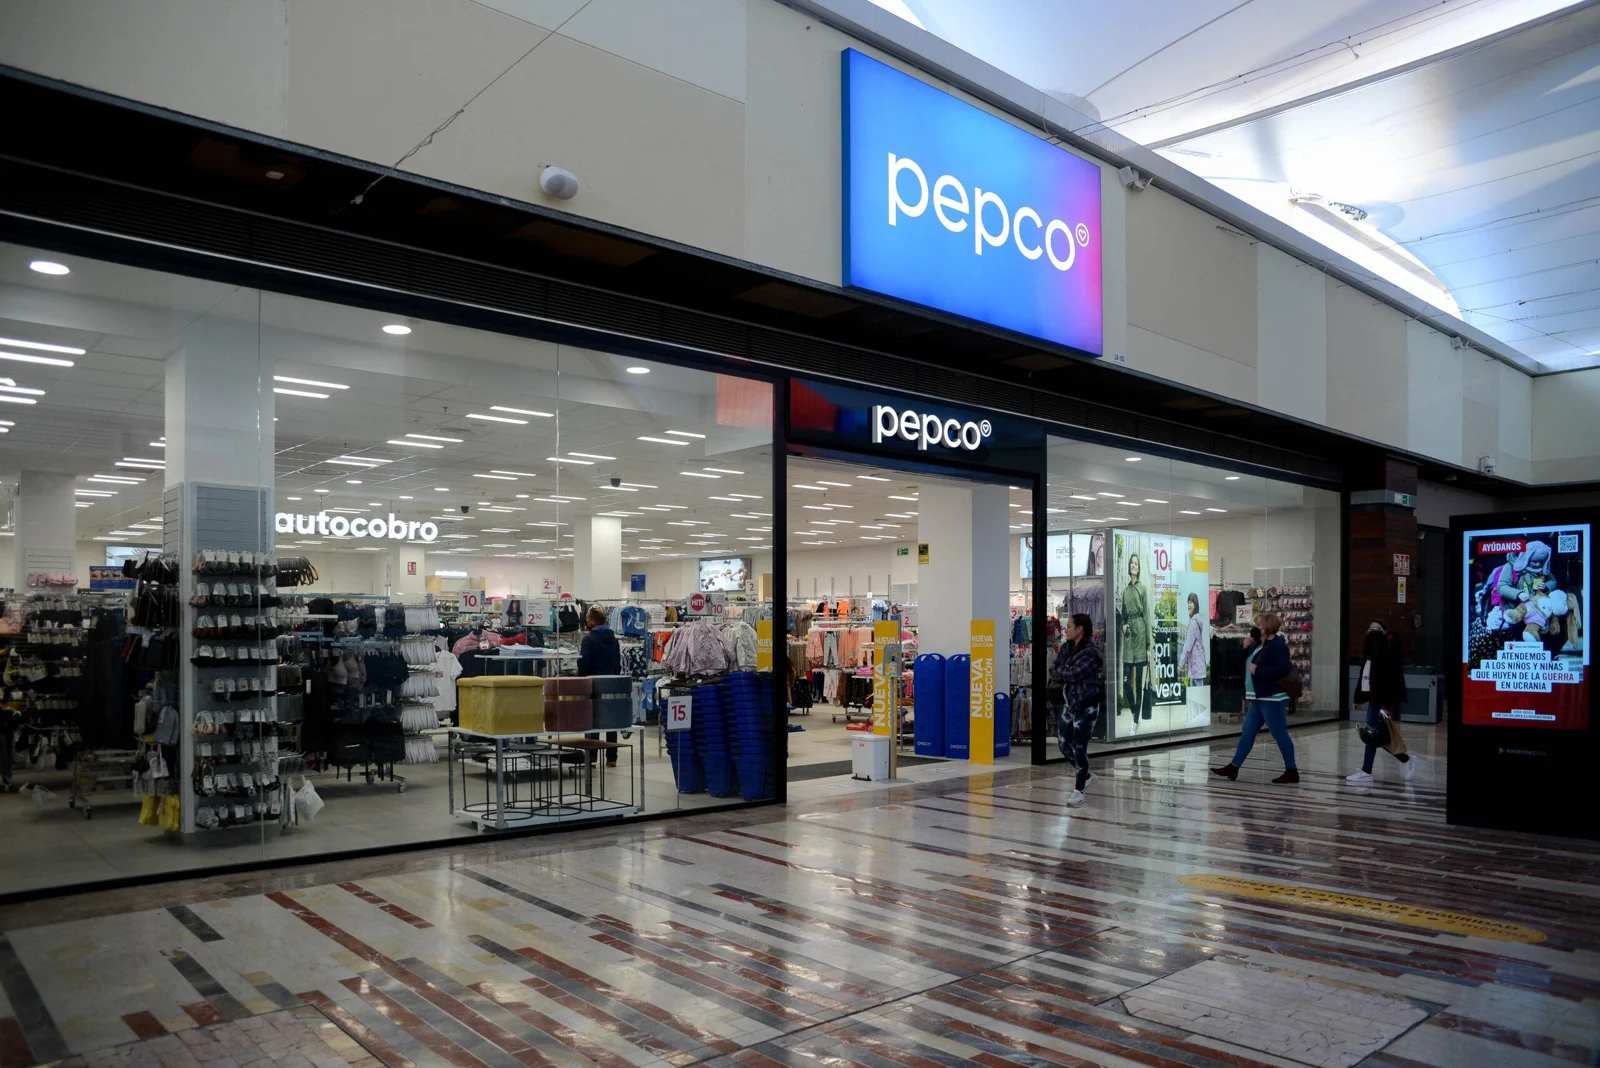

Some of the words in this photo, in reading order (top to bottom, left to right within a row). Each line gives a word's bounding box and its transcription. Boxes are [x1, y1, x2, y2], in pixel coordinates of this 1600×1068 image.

[888, 152, 1076, 271] pepco
[871, 405, 981, 450] pepco
[275, 511, 438, 541] autocobro
[1482, 541, 1521, 552] AYÚDANOS
[712, 603, 723, 614] 10
[875, 636, 896, 645] NUEVA
[1501, 652, 1546, 661] ATENDEMOS
[1492, 662, 1505, 670] LOS
[1508, 661, 1531, 671] NIÑOS
[1540, 661, 1563, 671] NIÑAS
[1476, 671, 1490, 679] QUE
[1492, 672, 1517, 680] HUYEN
[1520, 672, 1528, 680] DE
[1542, 673, 1574, 681] GUERRA
[971, 658, 984, 718] NUEVA
[984, 658, 993, 719] COLECCIÓN
[1155, 682, 1181, 698] vera
[1501, 681, 1511, 689] EN
[1513, 682, 1547, 691] UCRANIA
[874, 663, 886, 727] NUEVA
[1302, 890, 1382, 907] DISTANCIA
[1415, 909, 1519, 930] SEGURIDAD
